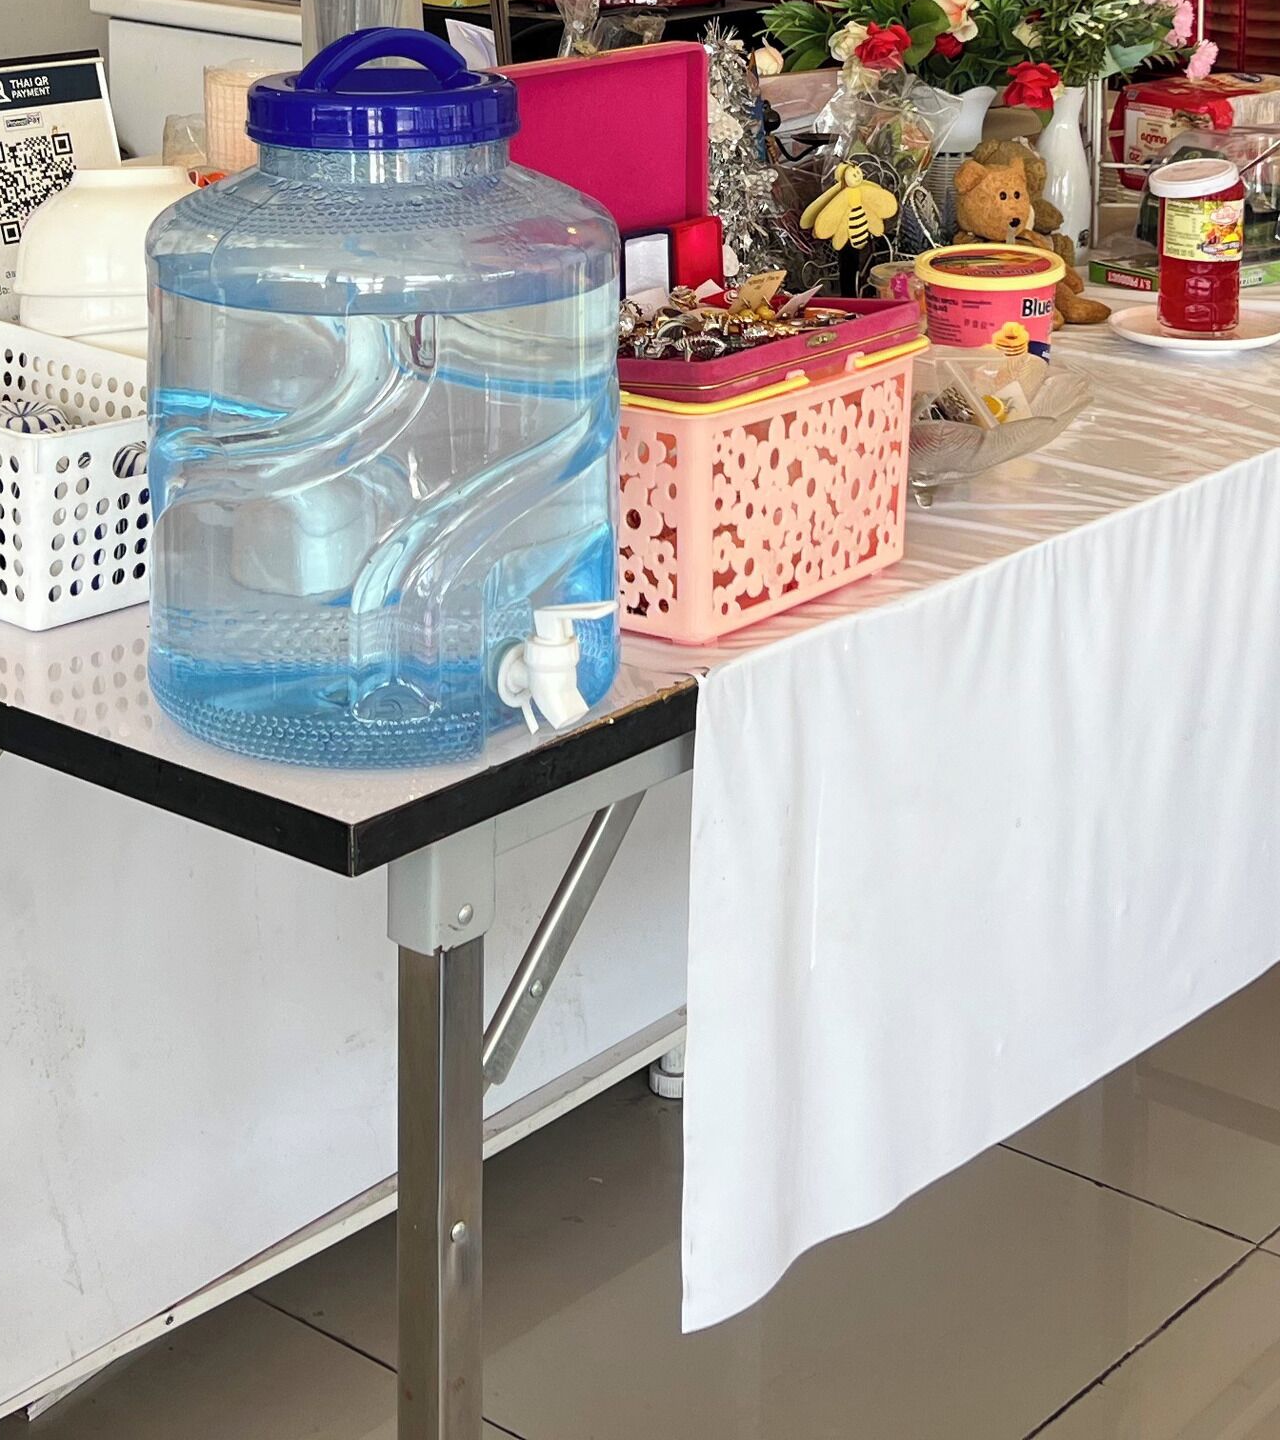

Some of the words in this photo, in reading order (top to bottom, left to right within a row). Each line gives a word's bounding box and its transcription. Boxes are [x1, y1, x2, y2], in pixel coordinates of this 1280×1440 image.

[9, 79, 33, 90] THAI
[34, 76, 50, 85] QR
[11, 86, 51, 99] PAYMENT
[1022, 298, 1051, 317] Blue
